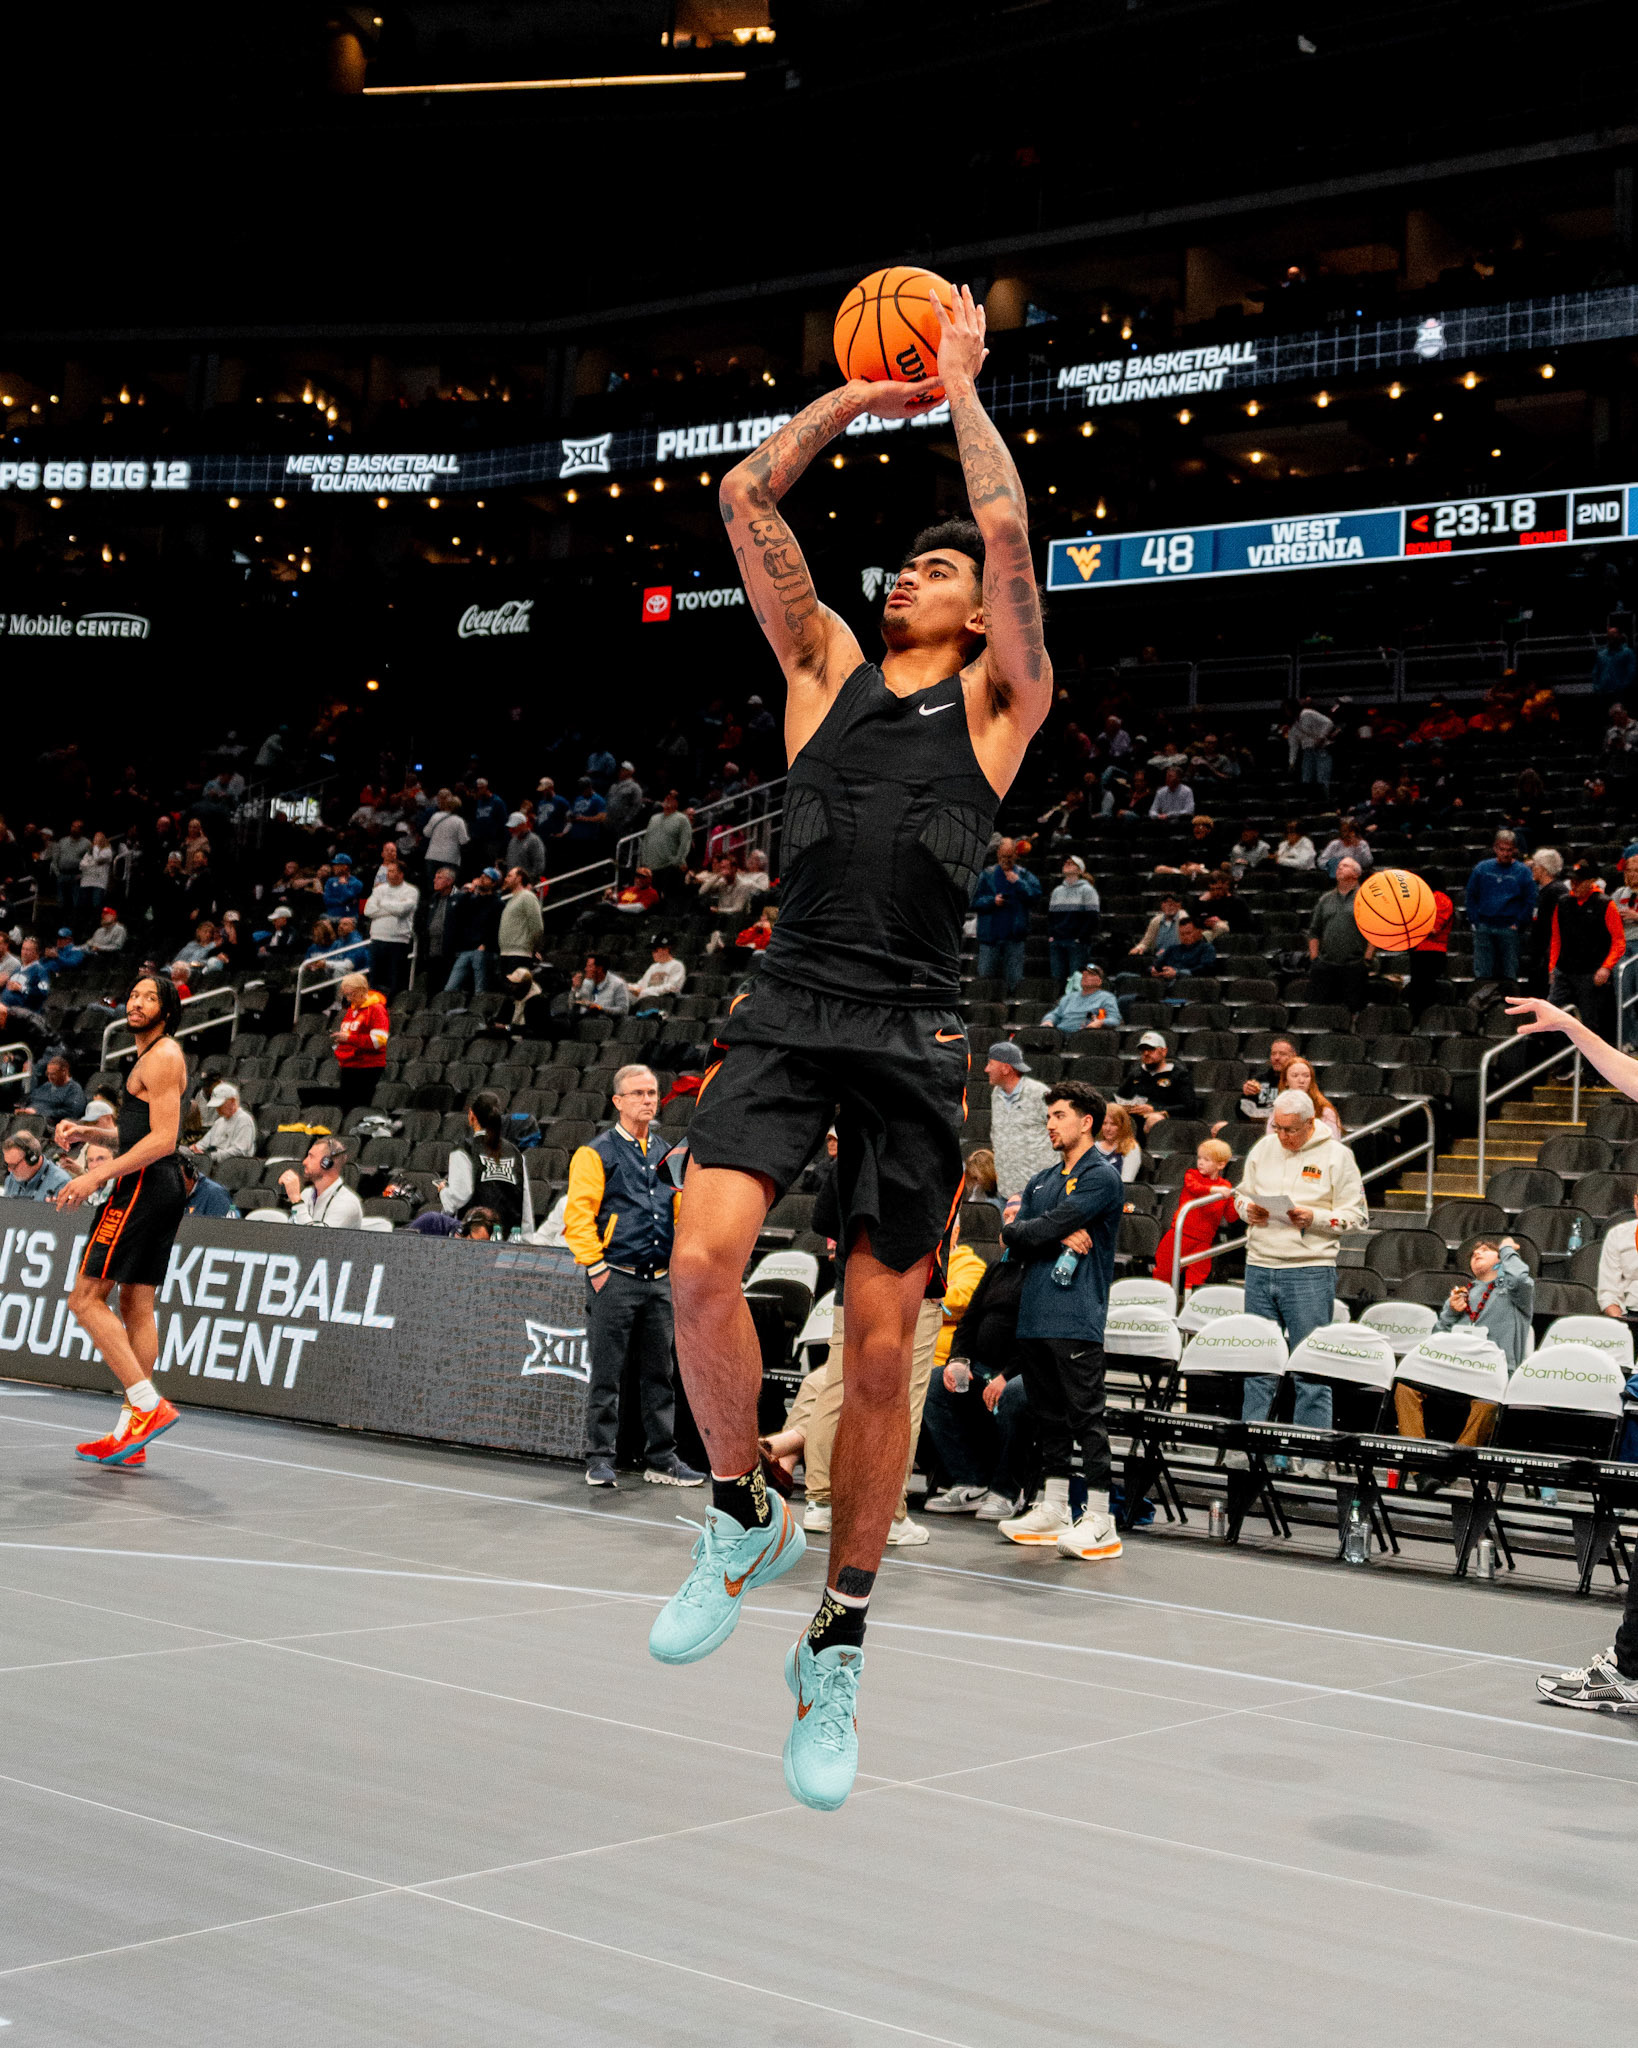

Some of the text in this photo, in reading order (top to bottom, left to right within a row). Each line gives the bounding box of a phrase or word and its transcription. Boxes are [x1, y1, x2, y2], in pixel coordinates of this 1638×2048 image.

[1057, 341, 1257, 389] MEN'S BASKETBALL
[1086, 367, 1229, 407] TOURNAMENT
[43, 461, 87, 490] 66
[90, 461, 148, 490] BIG
[151, 461, 190, 490] 12
[286, 454, 460, 473] MEN'S BASKETBALL
[311, 473, 436, 492] TOURNAMENT
[1434, 499, 1537, 538] 23:18
[1576, 501, 1621, 525] 2ND
[1271, 518, 1341, 544] WEST
[1519, 529, 1568, 545] BONUS
[1141, 534, 1195, 574] 48
[1247, 536, 1364, 567] VIRGINIA
[1406, 540, 1452, 556] BONUS
[675, 587, 745, 611] TOYOTA
[8, 614, 73, 636] Mobile
[76, 620, 143, 637] CENTER
[95, 1208, 124, 1246] POKES
[64, 1234, 395, 1330] KETBALL
[0, 1291, 319, 1389] OURMENT
[1195, 1335, 1278, 1348] bambooHR
[1523, 1363, 1617, 1385] bambooHR
